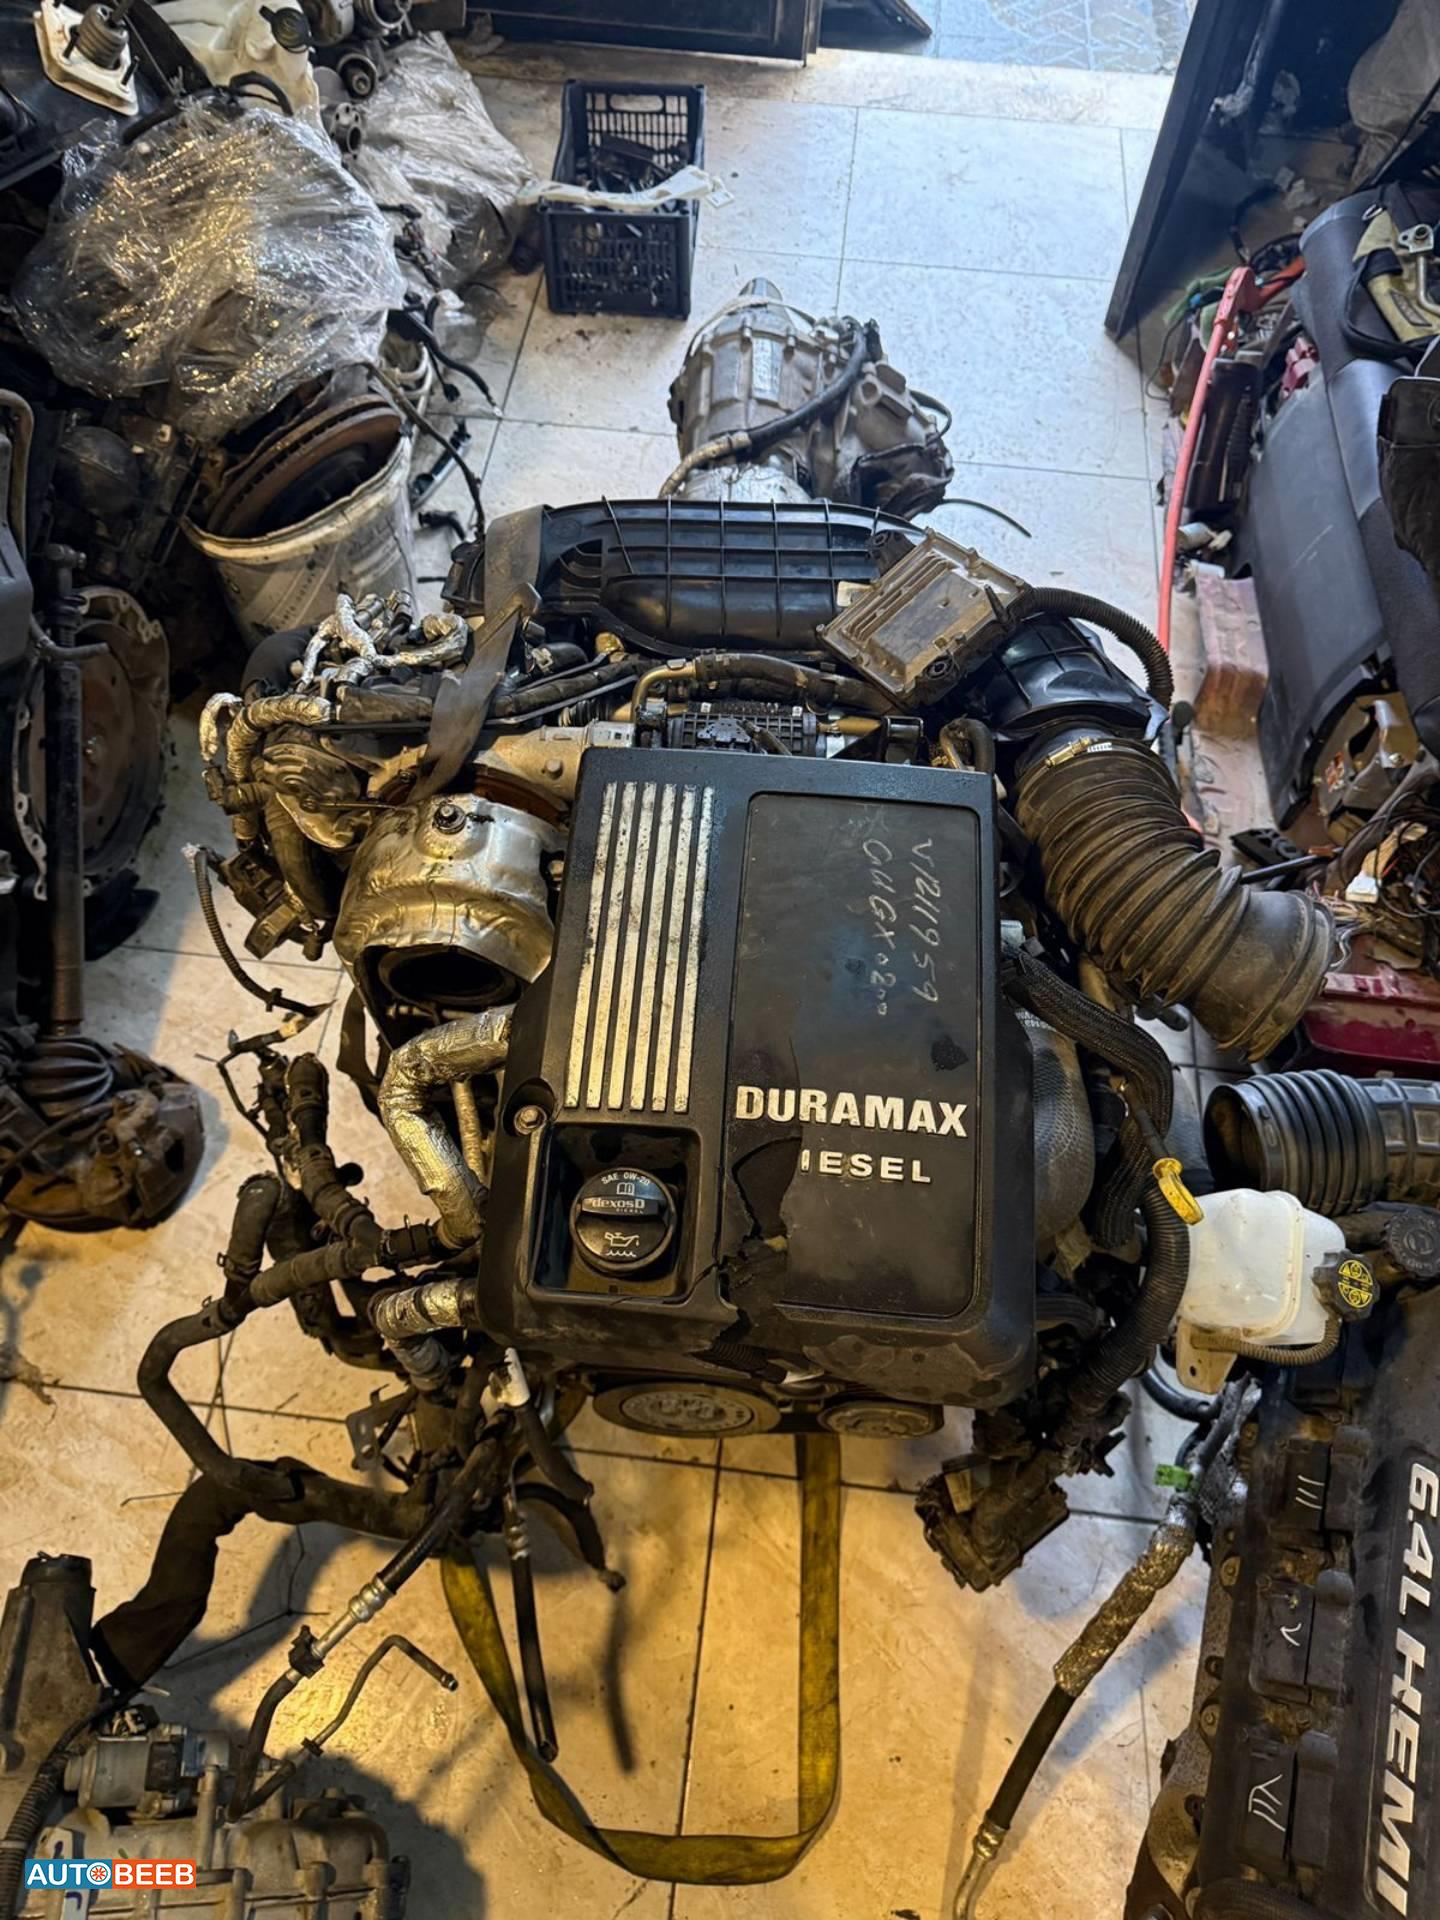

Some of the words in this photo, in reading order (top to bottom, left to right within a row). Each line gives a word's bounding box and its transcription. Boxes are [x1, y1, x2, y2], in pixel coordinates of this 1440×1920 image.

[735, 1085, 968, 1138] DURAMAX
[601, 1172, 619, 1185] SAE
[1399, 1462, 1440, 1617] 6.4L
[1376, 1627, 1427, 1918] HEMI
